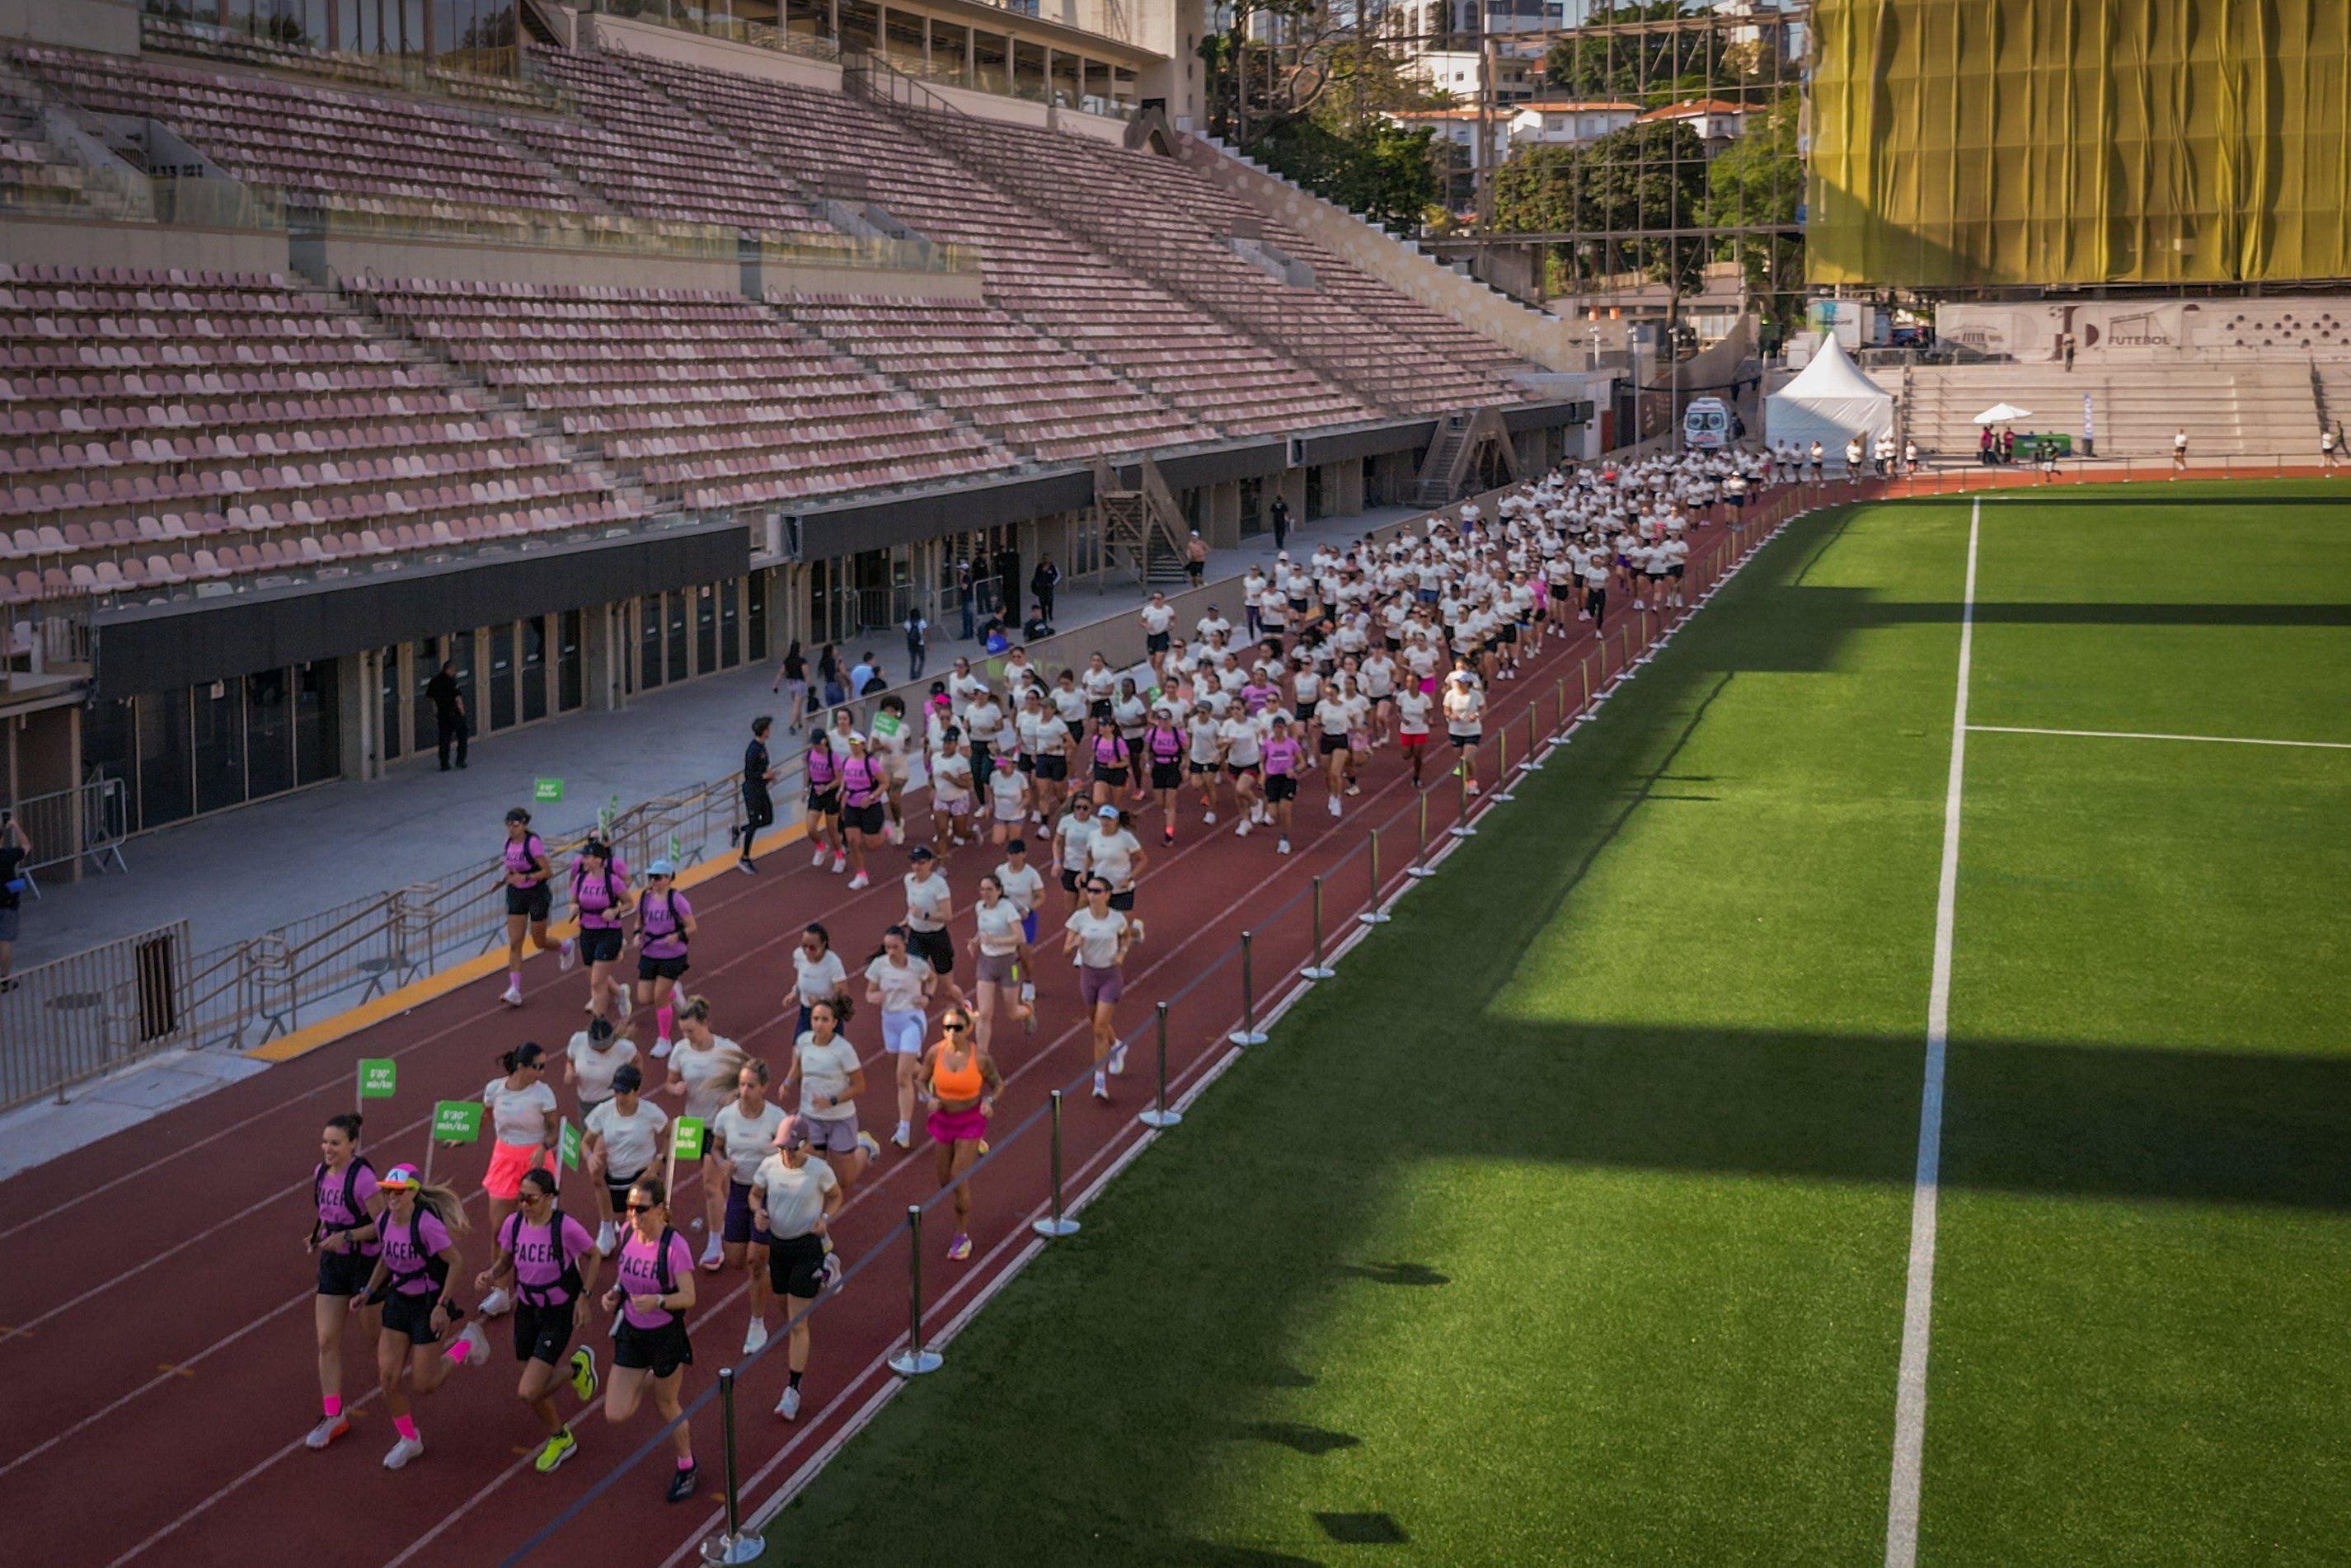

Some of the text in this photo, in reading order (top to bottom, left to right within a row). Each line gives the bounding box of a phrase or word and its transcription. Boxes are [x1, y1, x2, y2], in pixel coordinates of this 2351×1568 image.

[2108, 336, 2170, 345] FUTEBOL
[437, 1121, 470, 1132] min/km
[318, 1187, 347, 1206] ACER
[515, 1243, 556, 1263] PACER
